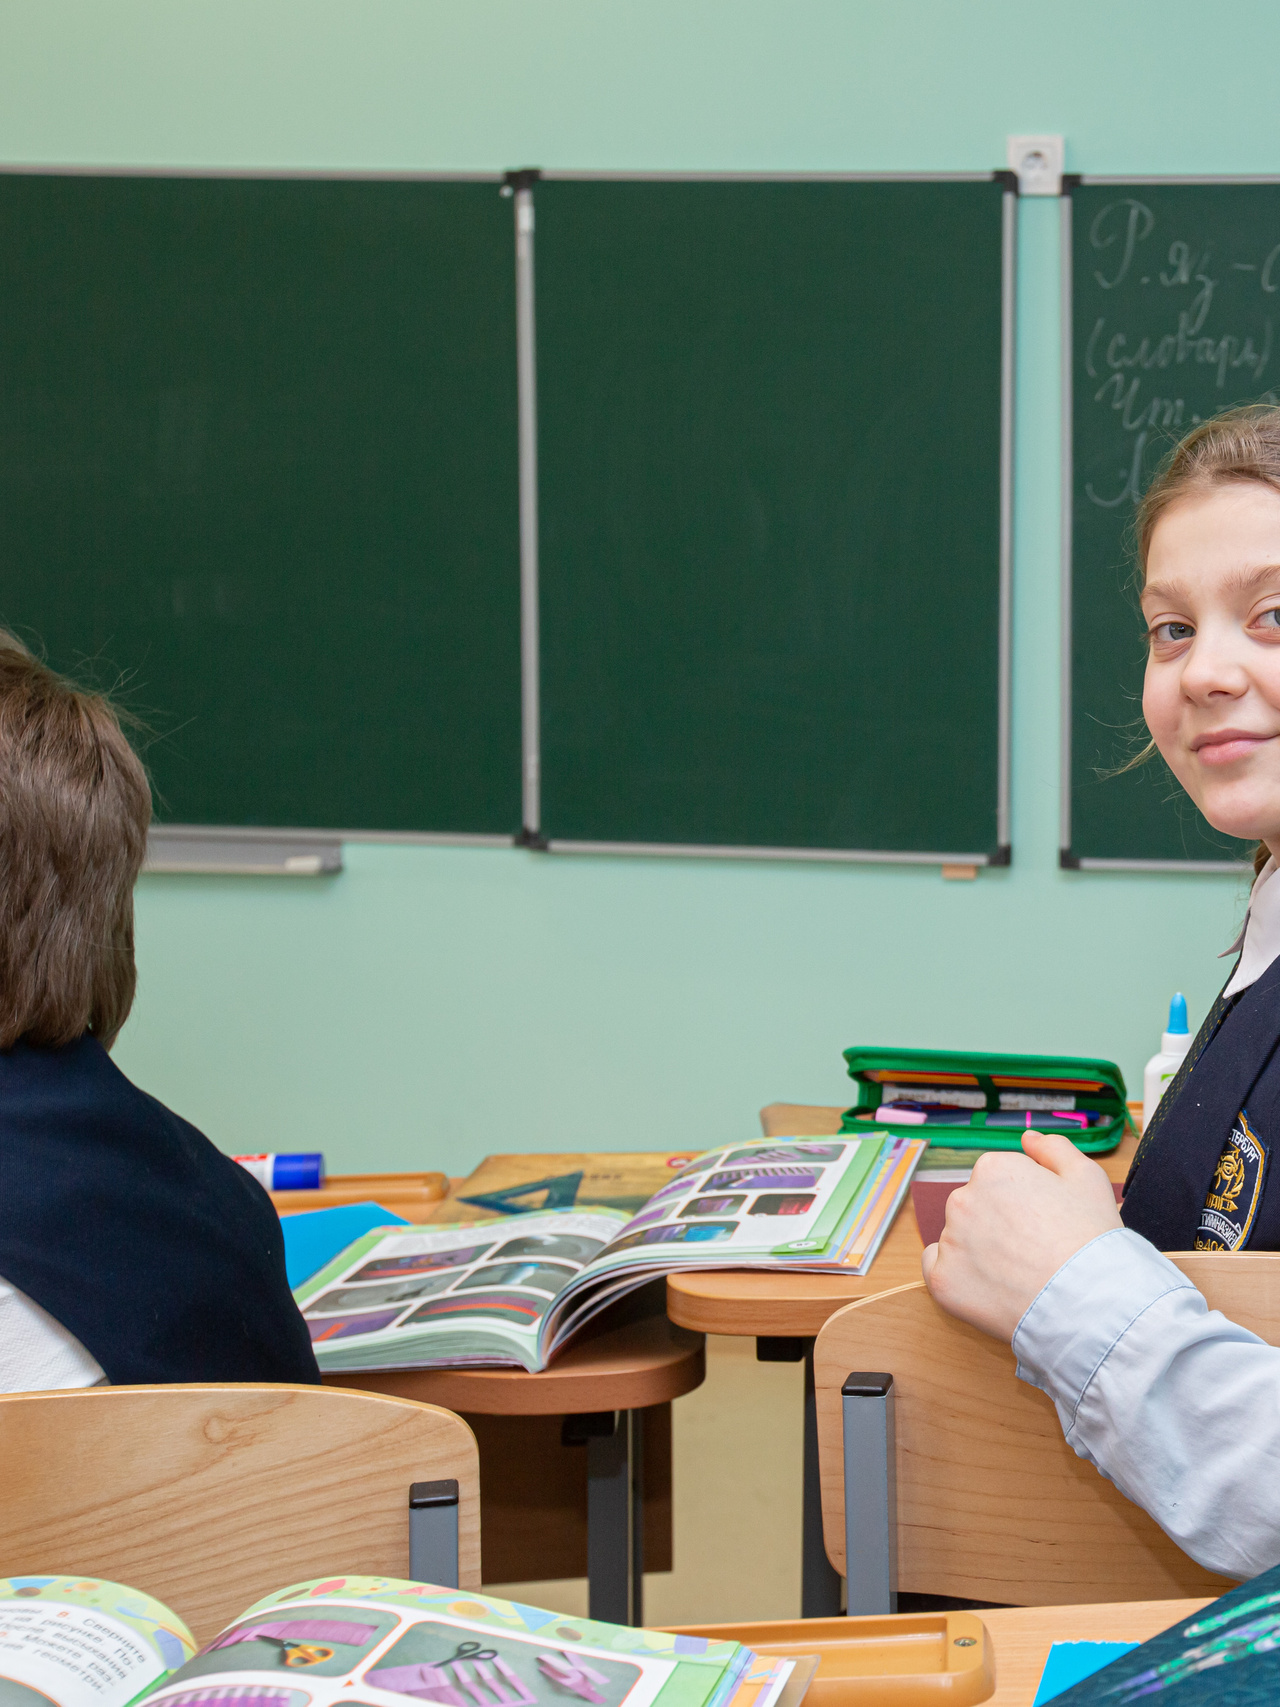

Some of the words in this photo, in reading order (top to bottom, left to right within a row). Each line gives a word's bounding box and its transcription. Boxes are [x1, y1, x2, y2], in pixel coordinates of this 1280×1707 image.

[1228, 1128, 1260, 1164] ТЕРБУРГ
[52, 1632, 127, 1680] высыхания
[82, 1618, 147, 1664] Сверните
